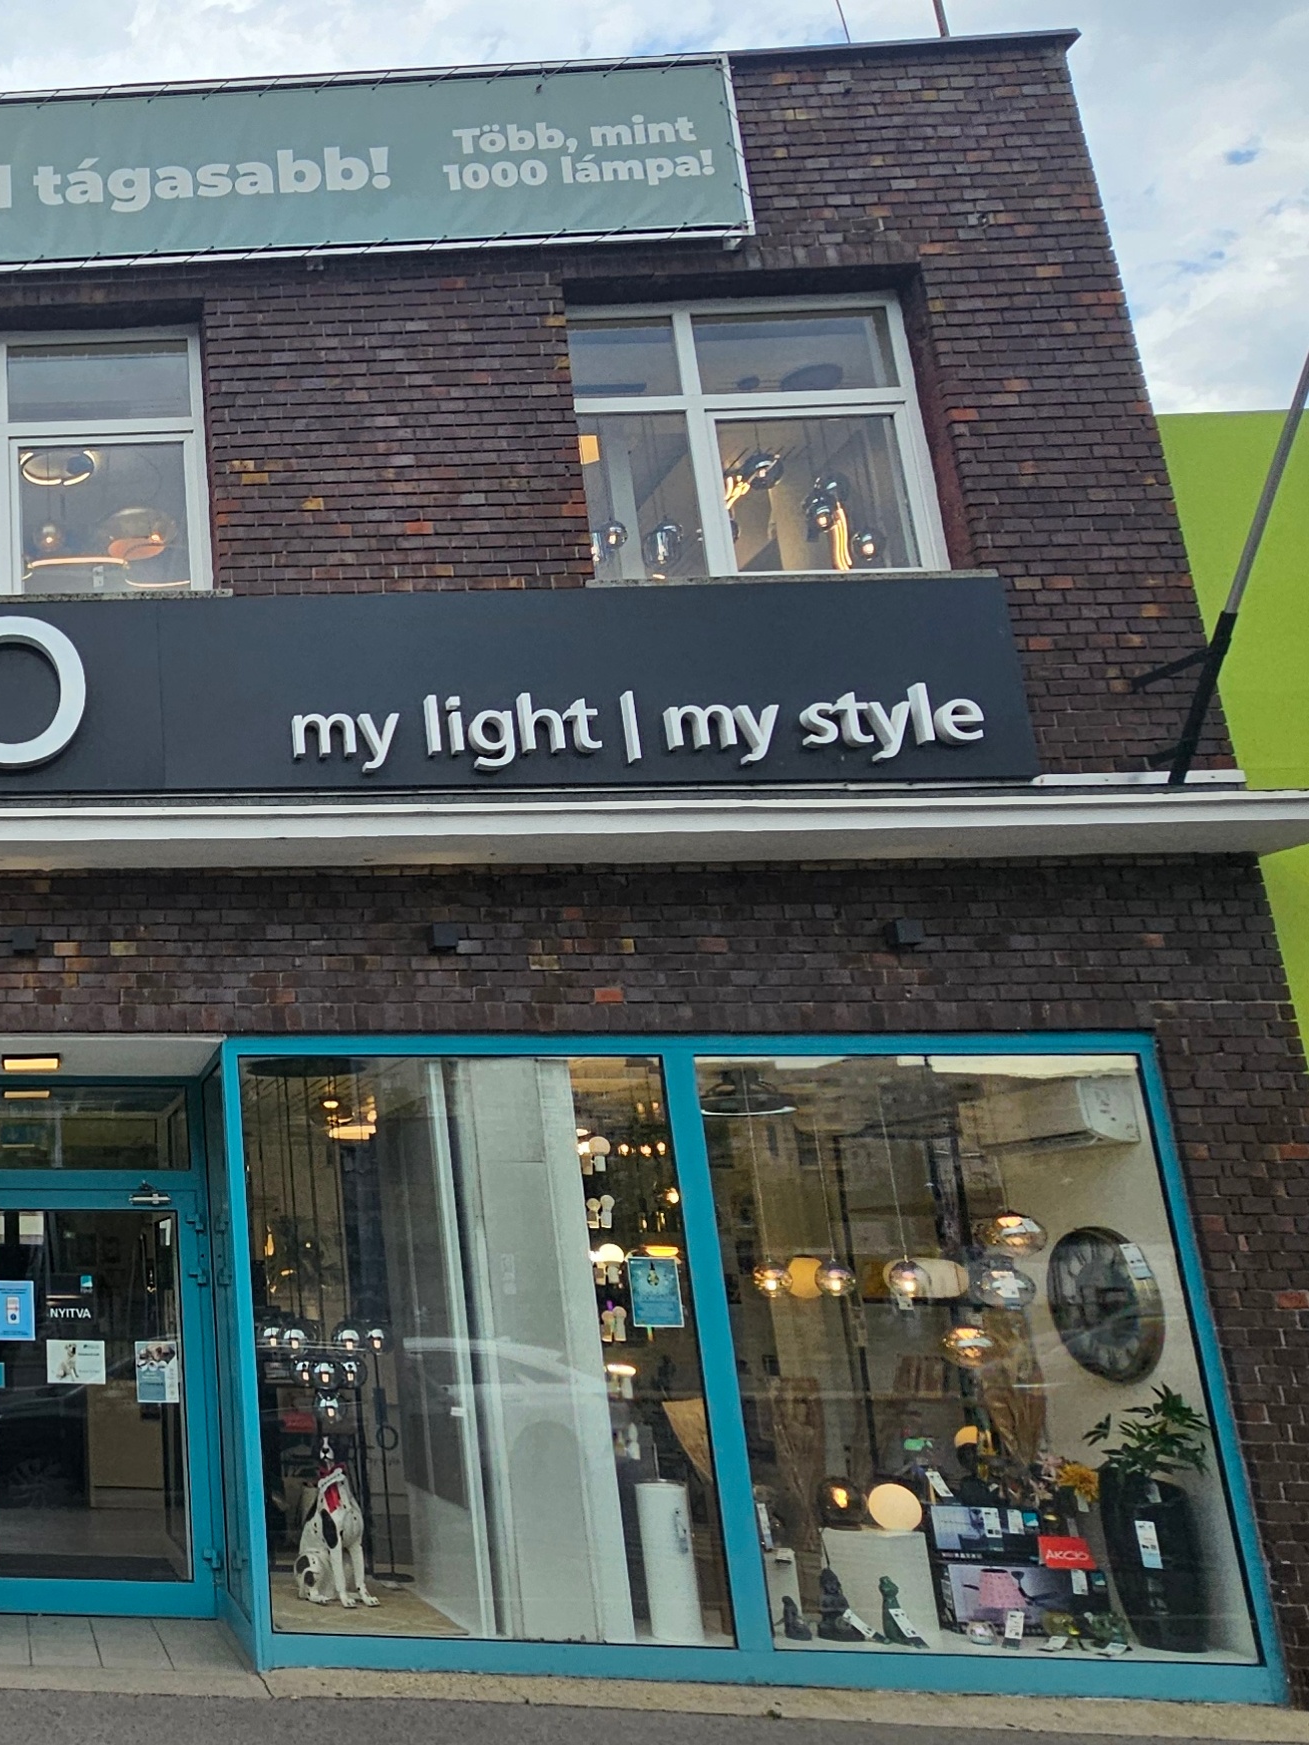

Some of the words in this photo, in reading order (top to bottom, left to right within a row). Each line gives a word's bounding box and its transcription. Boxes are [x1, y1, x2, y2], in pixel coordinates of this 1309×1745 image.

[453, 121, 578, 154] Több,
[590, 114, 698, 148] mint
[32, 146, 391, 213] tágasabb!
[442, 160, 548, 191] 1000
[561, 149, 716, 186] lámpa!
[291, 710, 400, 773] my
[423, 692, 603, 771] light
[662, 702, 780, 766] my
[799, 682, 986, 762] style
[50, 1308, 92, 1319] NYITVA
